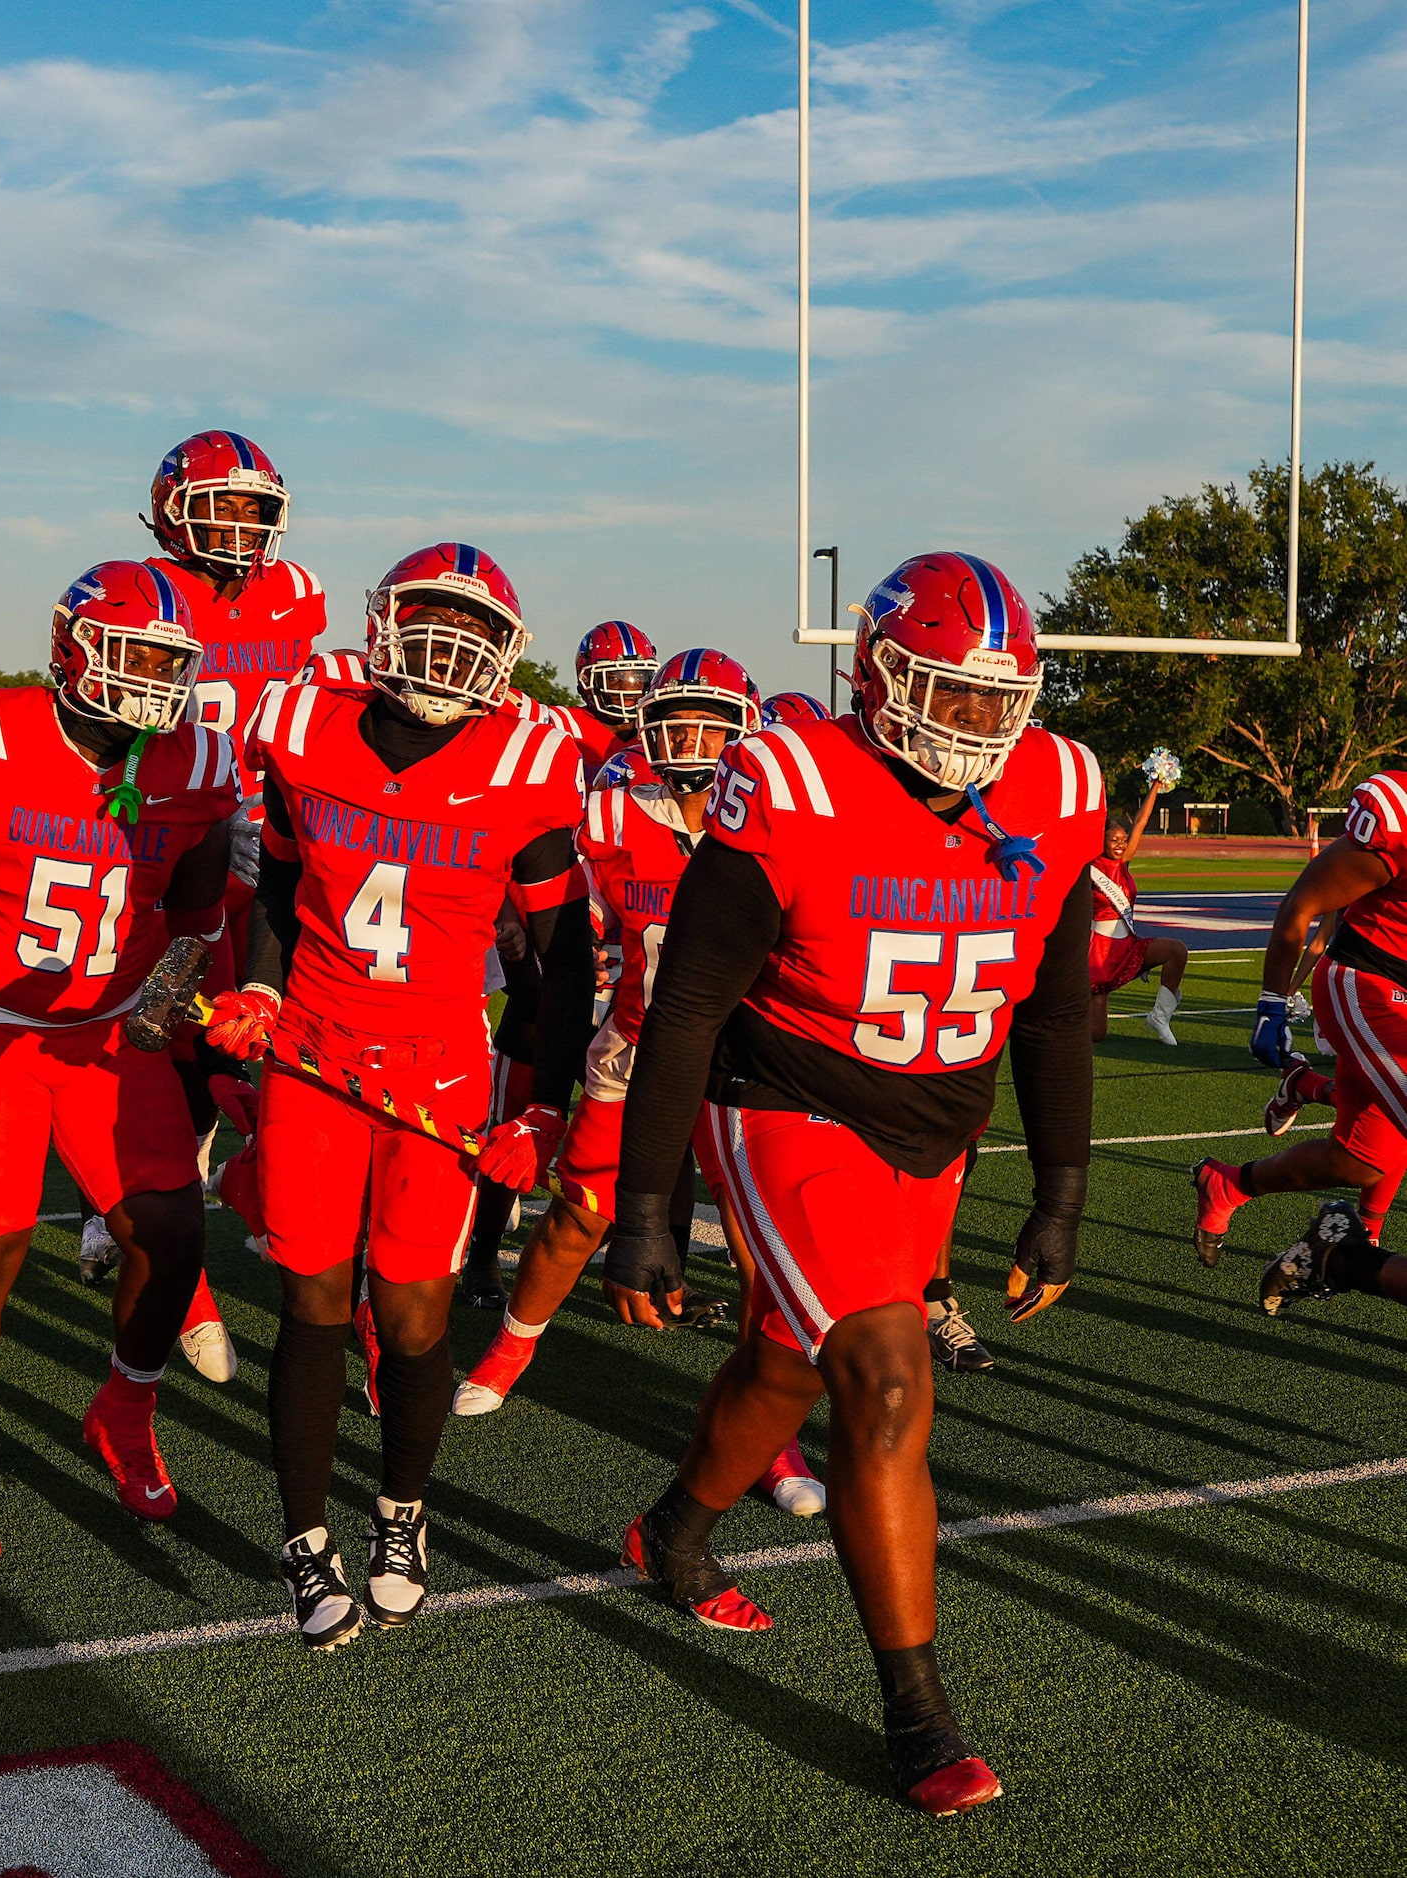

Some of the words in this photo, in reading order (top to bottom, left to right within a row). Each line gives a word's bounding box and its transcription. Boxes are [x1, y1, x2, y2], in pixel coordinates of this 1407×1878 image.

[195, 638, 301, 675] NCANVILLE
[705, 758, 759, 834] 55
[1345, 797, 1377, 845] 70
[8, 806, 171, 863] DUNCANVILLE
[300, 796, 488, 870] DUNCANVILLE
[17, 856, 130, 977] 51
[343, 860, 412, 983] 4
[849, 875, 1042, 923] DUNCANVILLE
[1097, 876, 1125, 907] Dancer
[850, 928, 1017, 1067] 55
